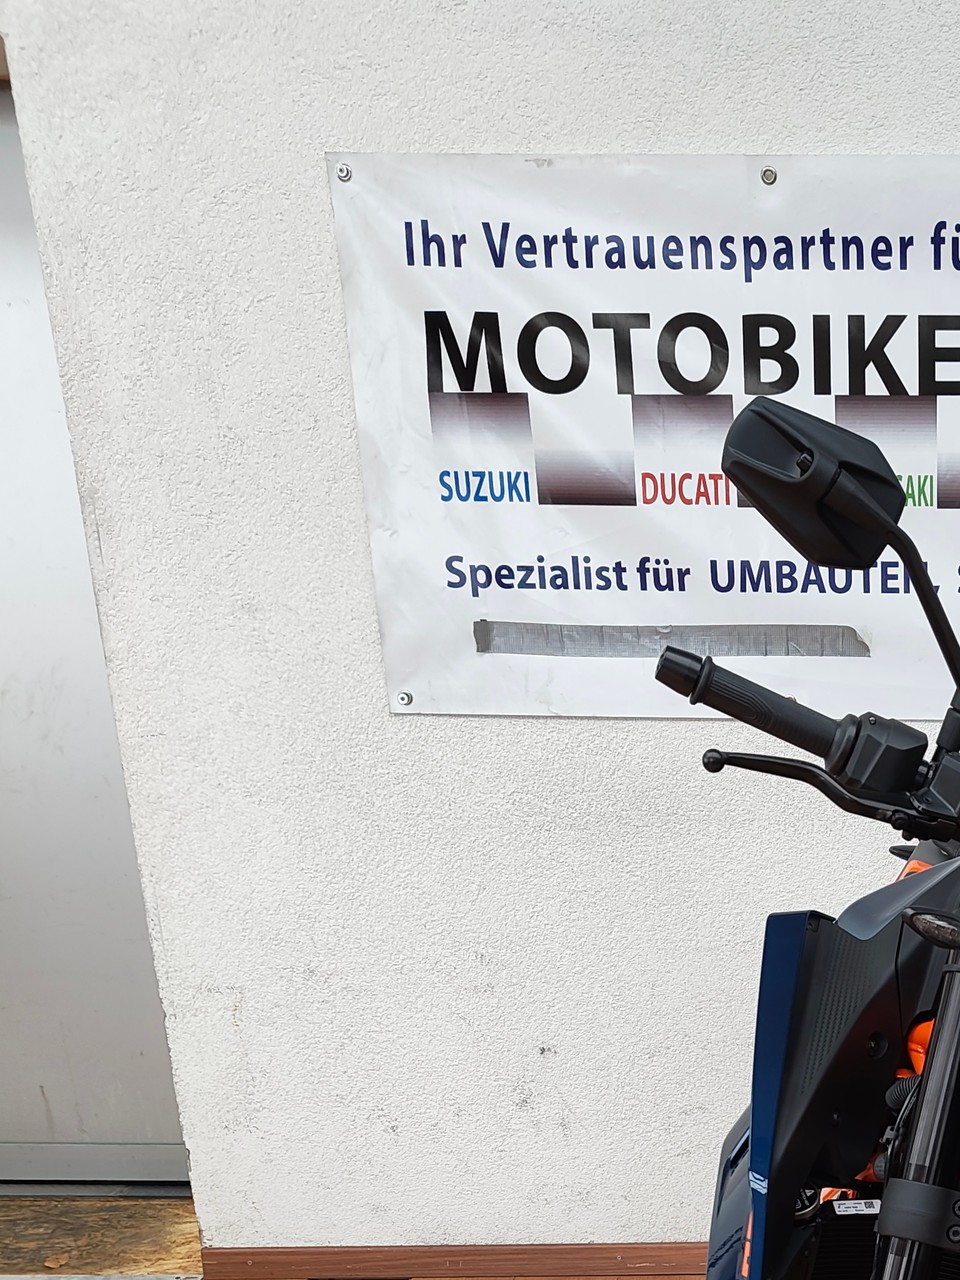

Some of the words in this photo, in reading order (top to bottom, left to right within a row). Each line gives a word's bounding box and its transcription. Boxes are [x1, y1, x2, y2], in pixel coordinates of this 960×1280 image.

[404, 219, 467, 268] Ihr
[481, 221, 914, 283] Vertrauenspartner
[438, 470, 531, 503] SUZUKI
[641, 472, 731, 506] DUCATI
[445, 554, 628, 598] Spezialist
[636, 556, 691, 592] für
